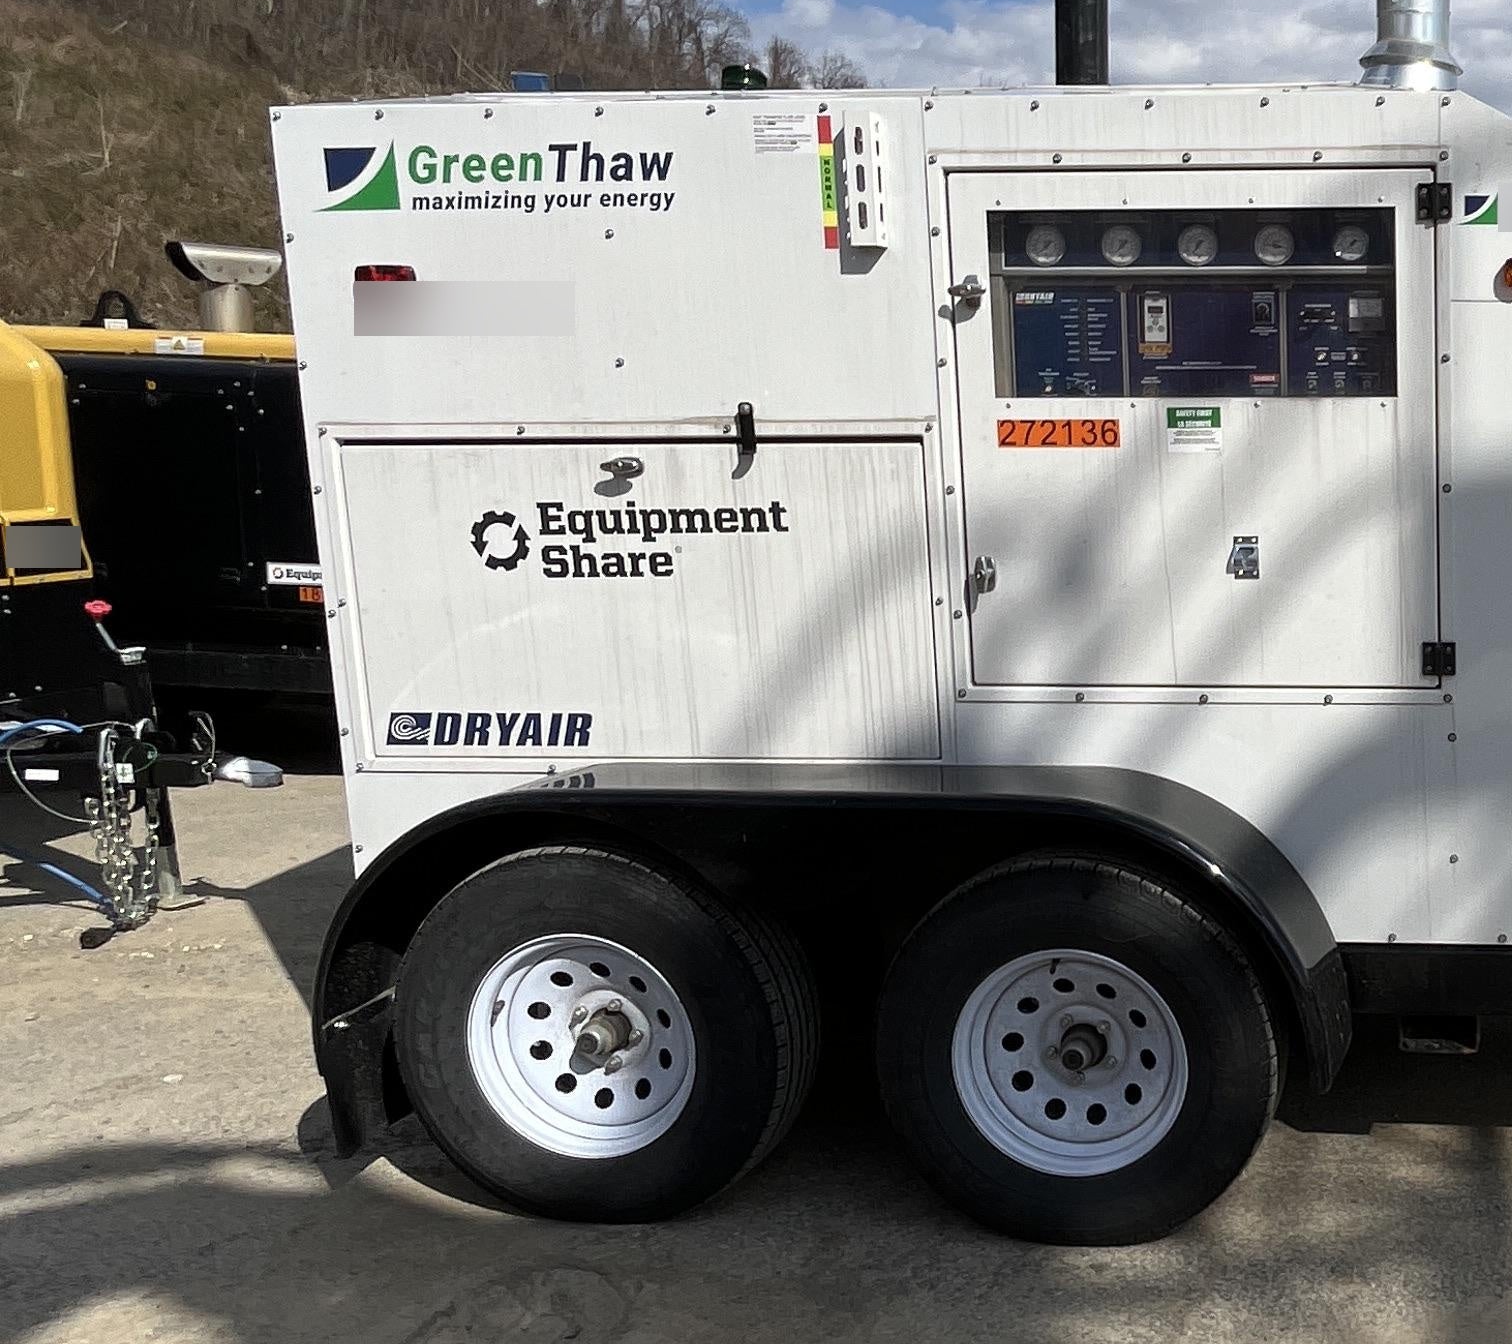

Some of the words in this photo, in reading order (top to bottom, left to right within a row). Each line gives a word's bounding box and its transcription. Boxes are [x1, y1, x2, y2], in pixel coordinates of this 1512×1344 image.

[823, 158, 833, 209] NORMAL
[411, 189, 537, 214] maximizing
[543, 192, 592, 214] your
[599, 191, 676, 212] energy
[999, 419, 1119, 447] 272136
[535, 501, 790, 544] Equipment
[286, 568, 322, 581] Equip
[541, 544, 675, 579] Share
[433, 712, 594, 747] DRYAIR
